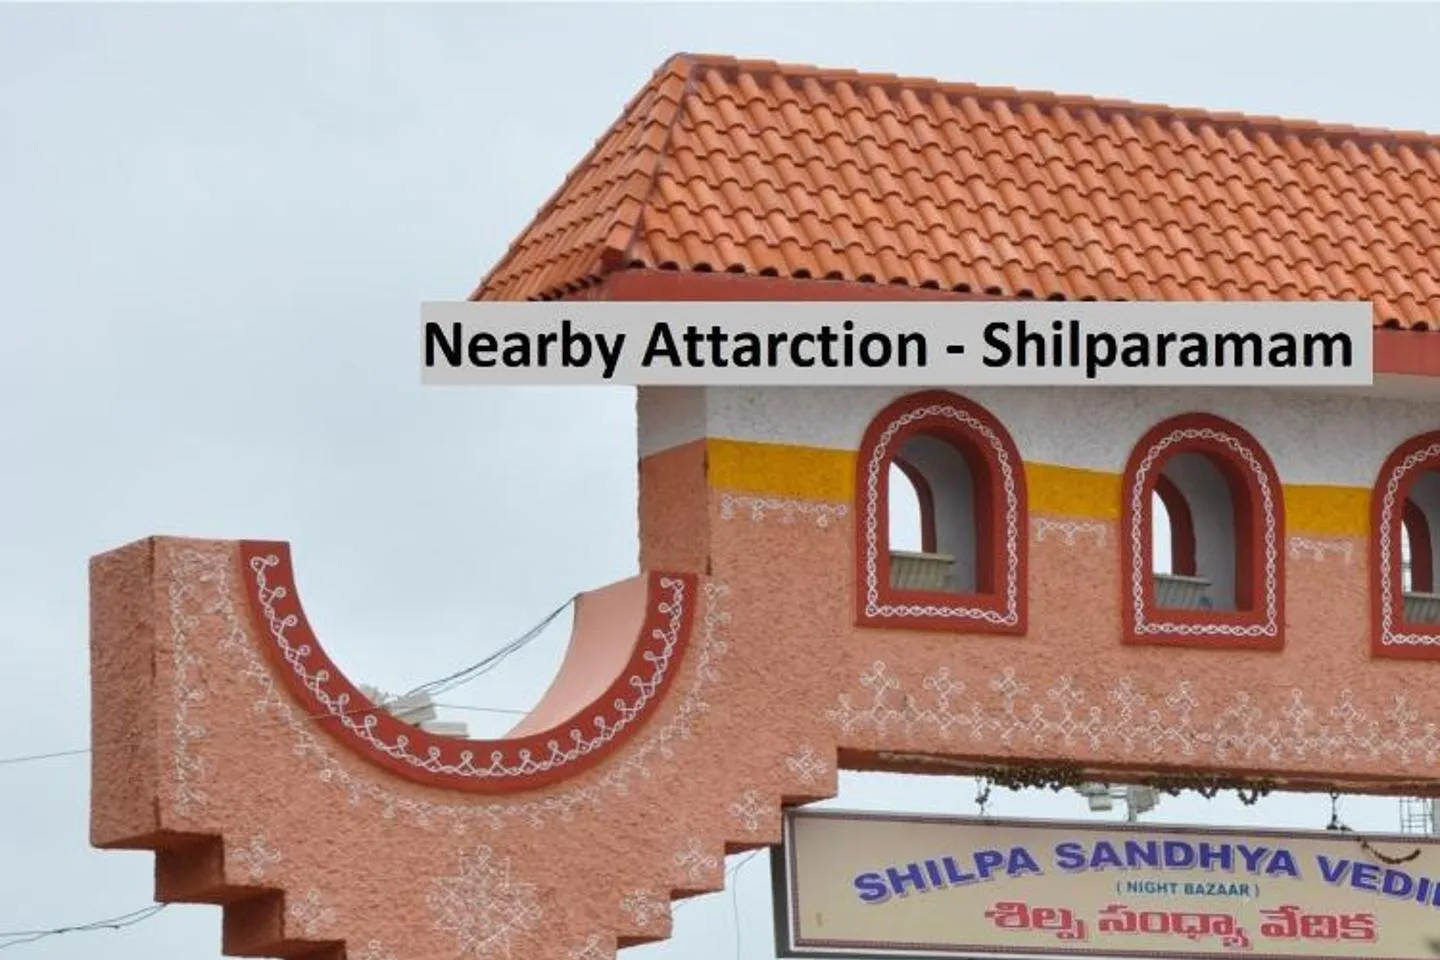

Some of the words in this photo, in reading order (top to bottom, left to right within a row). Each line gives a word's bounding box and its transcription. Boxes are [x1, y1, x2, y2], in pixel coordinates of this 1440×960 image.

[853, 846, 1044, 902] SHILPA
[1055, 840, 1300, 878] SANDHYA
[985, 900, 1088, 941] శిల్ప
[1259, 904, 1378, 942] వేదిక
